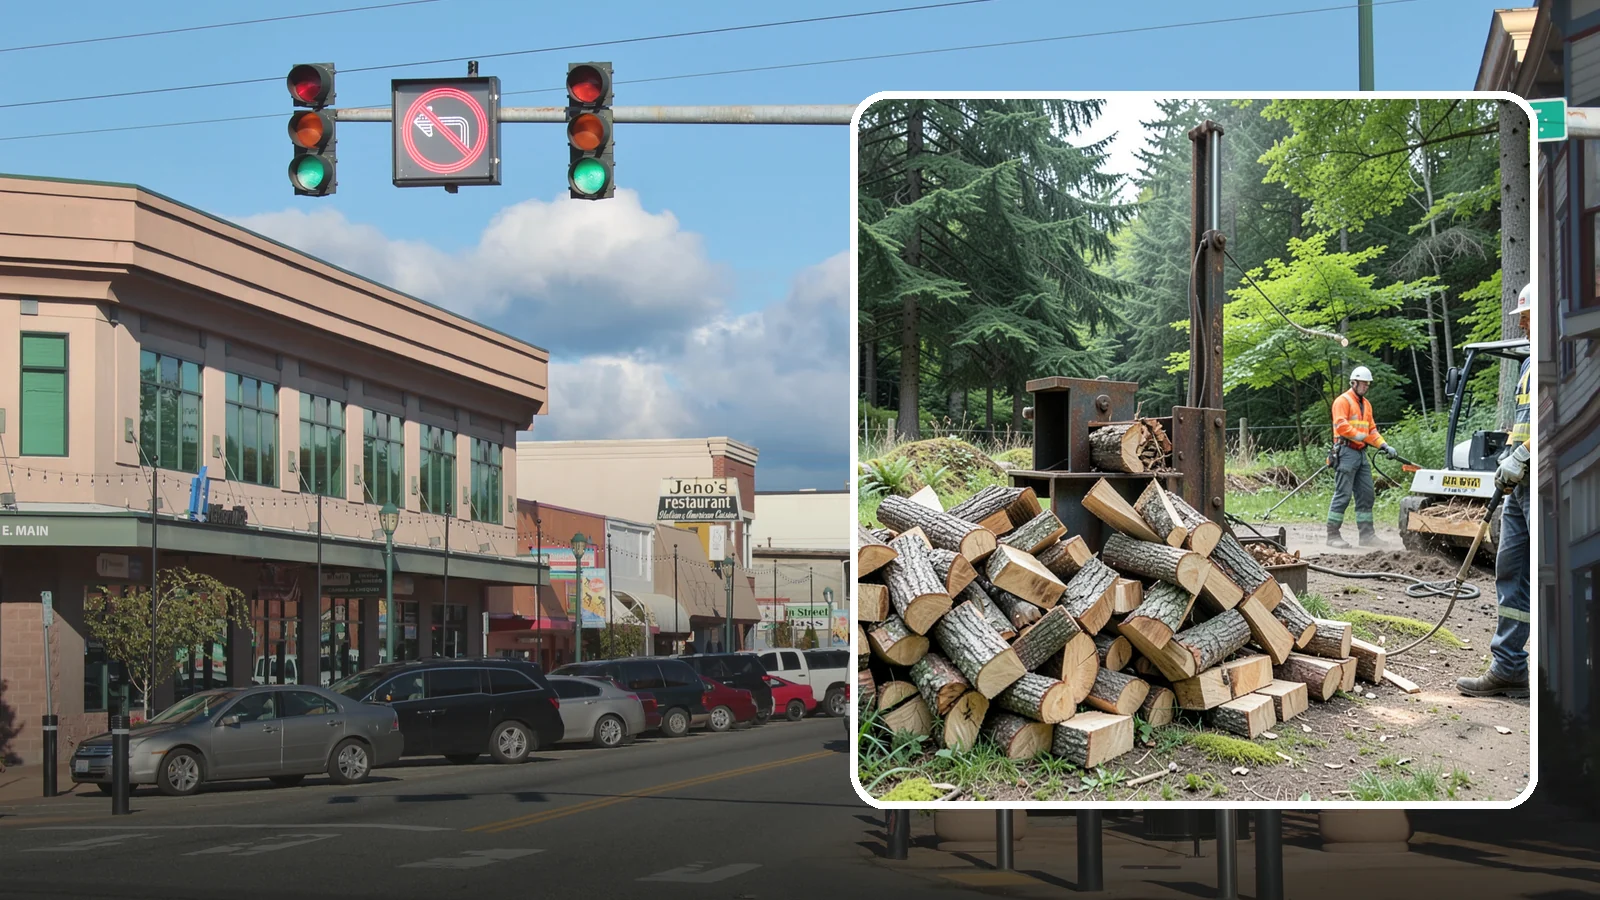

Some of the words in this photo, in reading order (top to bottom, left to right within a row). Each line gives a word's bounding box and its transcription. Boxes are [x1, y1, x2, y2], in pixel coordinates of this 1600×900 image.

[669, 479, 728, 495] Jeno's
[664, 496, 731, 509] restaurant
[685, 509, 715, 520] American
[714, 509, 737, 520] Cuisine
[2, 525, 13, 536] E.
[15, 525, 49, 537] MAIN
[797, 607, 828, 617] Street
[790, 619, 824, 627] lass
